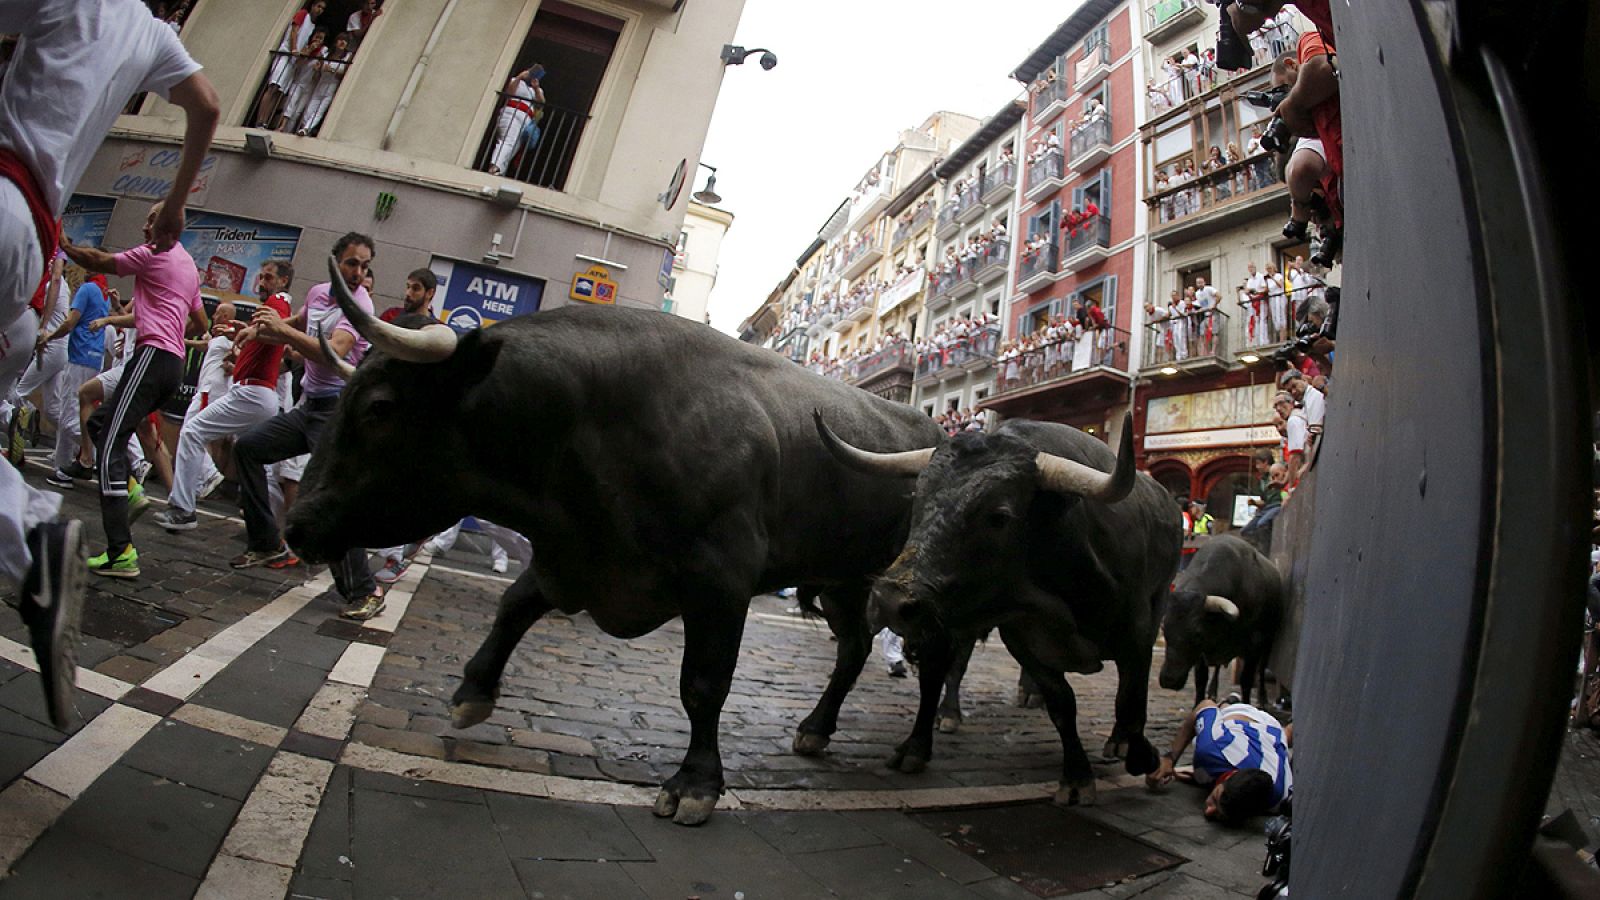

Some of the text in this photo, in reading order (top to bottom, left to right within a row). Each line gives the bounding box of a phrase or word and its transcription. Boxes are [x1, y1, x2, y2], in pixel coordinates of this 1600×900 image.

[150, 150, 216, 172] coe
[214, 228, 258, 240] Trident
[588, 270, 607, 278] ATM
[467, 277, 519, 303] ATM
[482, 299, 515, 316] HERE
[1193, 384, 1270, 419] FARMACI
